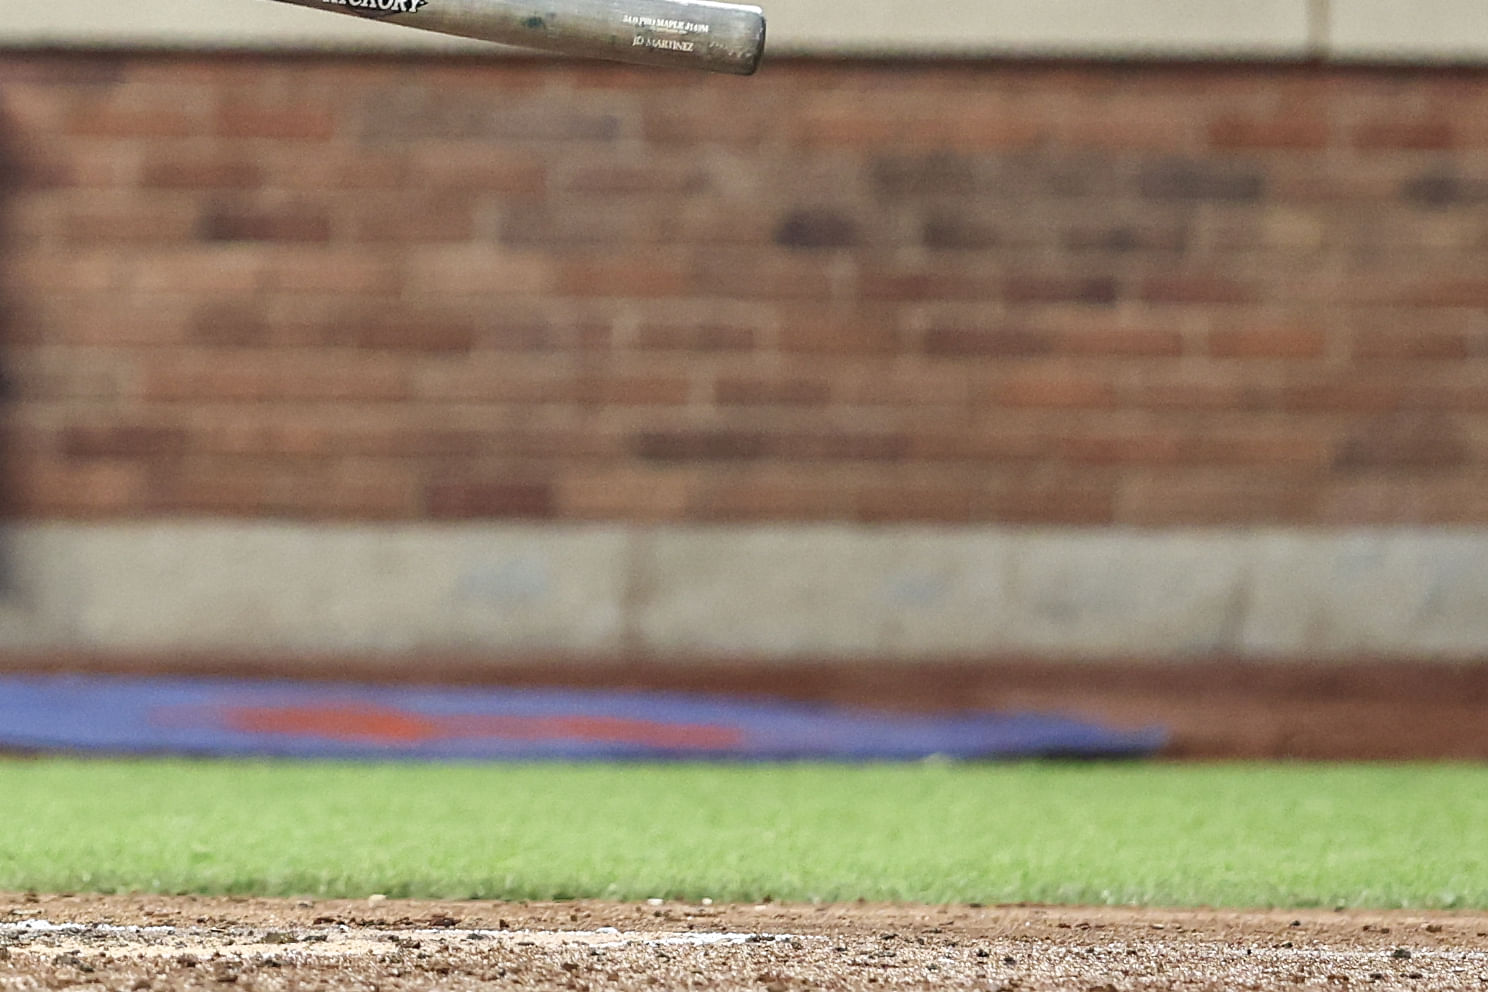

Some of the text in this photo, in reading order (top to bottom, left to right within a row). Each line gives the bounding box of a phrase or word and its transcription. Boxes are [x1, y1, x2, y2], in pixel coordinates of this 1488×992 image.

[657, 18, 685, 29] MAPLE
[632, 35, 645, 47] JD
[645, 38, 695, 52] MARTINEZ
